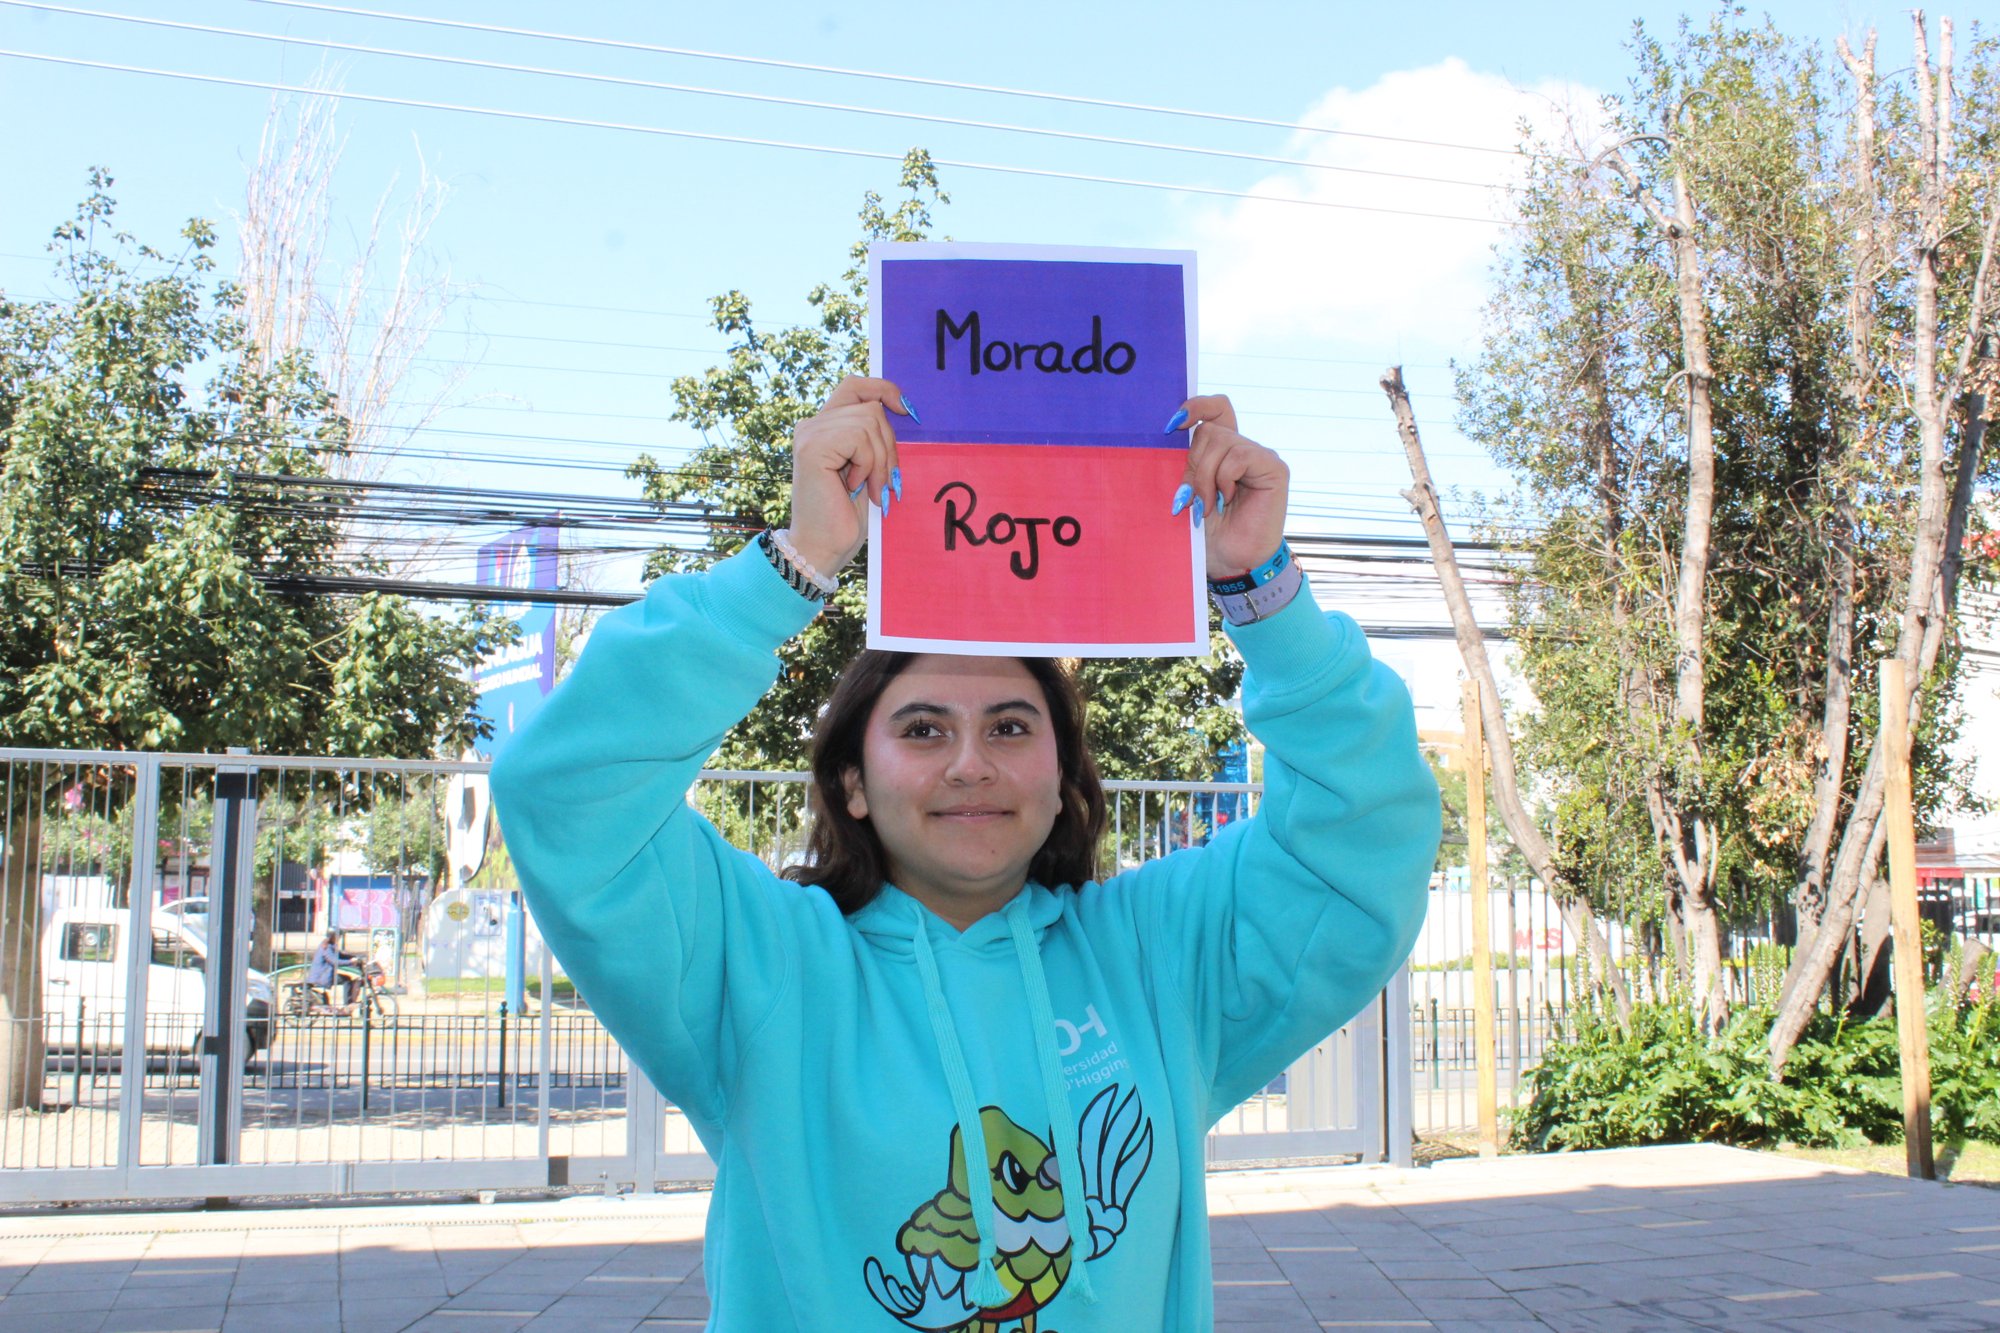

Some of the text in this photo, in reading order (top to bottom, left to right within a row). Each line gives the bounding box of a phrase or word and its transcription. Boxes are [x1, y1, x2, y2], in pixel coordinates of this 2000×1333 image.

[935, 308, 1137, 376] Morado
[1216, 580, 1246, 593] 1955
[1063, 1040, 1119, 1076] ersidad
